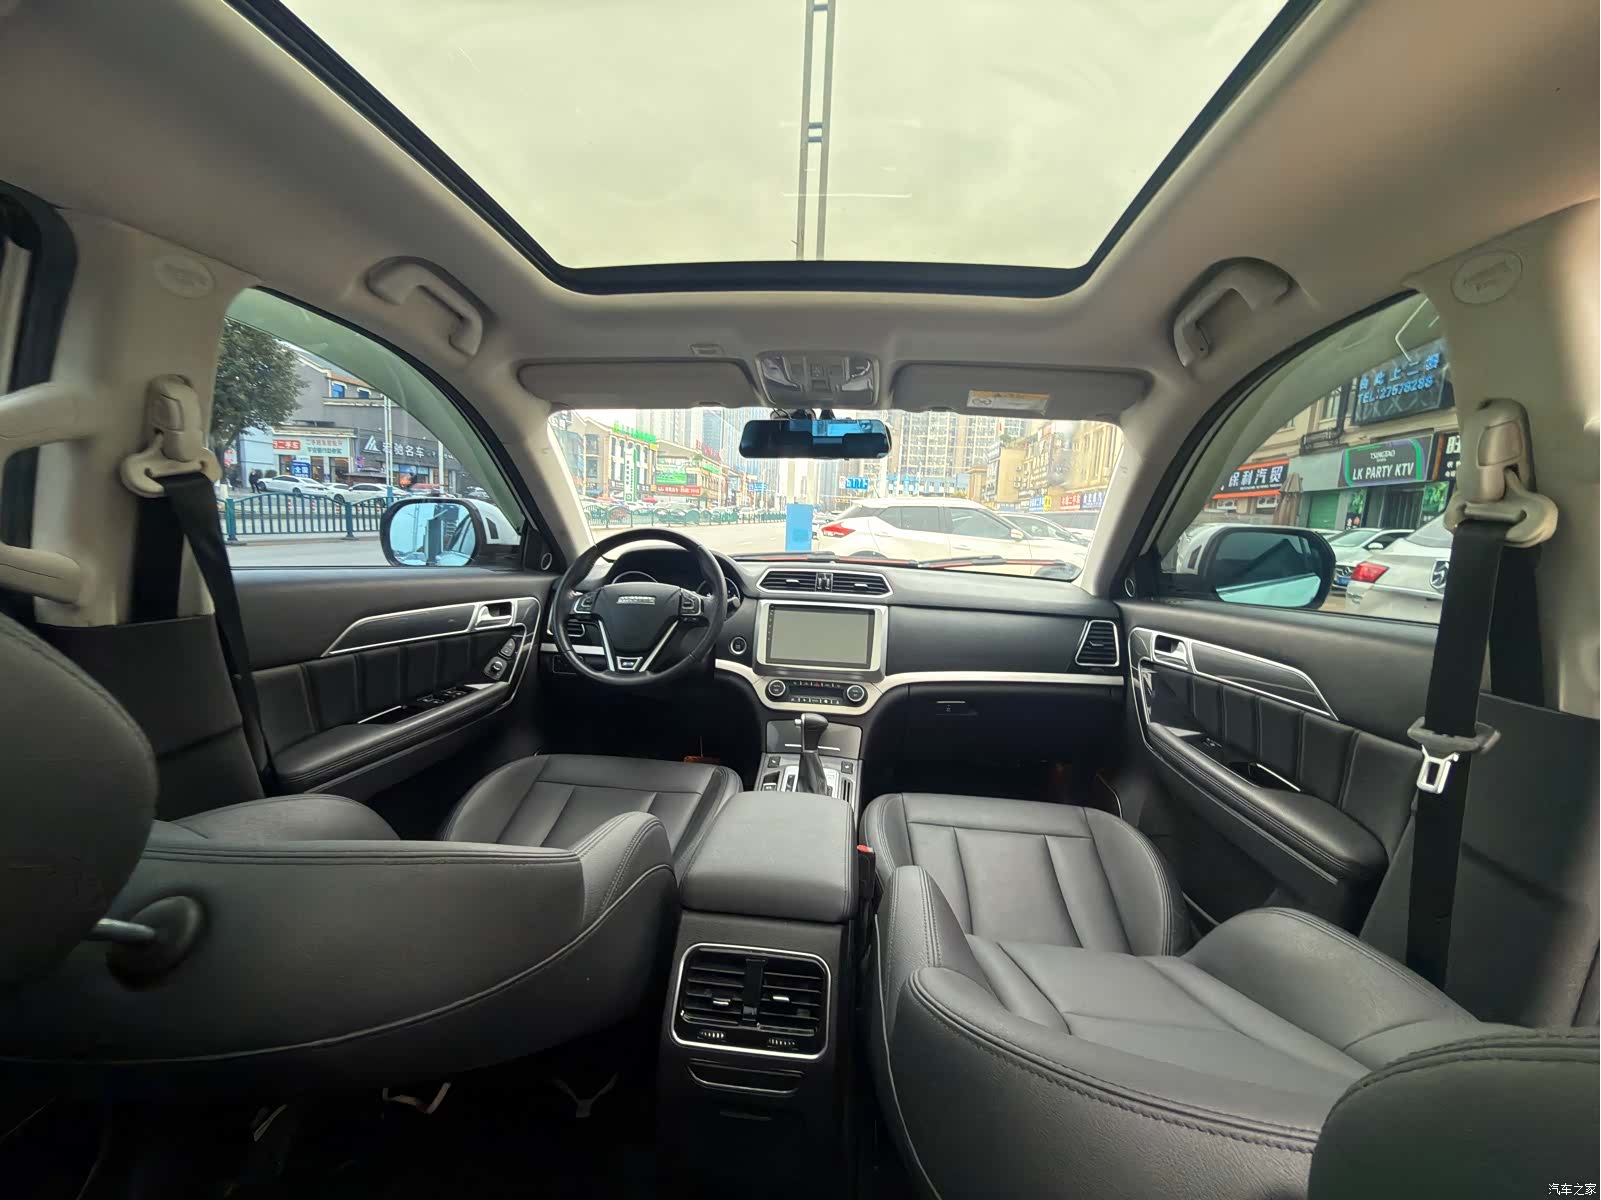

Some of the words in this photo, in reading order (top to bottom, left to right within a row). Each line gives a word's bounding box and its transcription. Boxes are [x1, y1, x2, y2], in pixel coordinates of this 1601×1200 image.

[1228, 465, 1284, 488] 保利汽贸
[1352, 467, 1364, 481] LK
[1365, 464, 1393, 480] PARTY
[1395, 462, 1414, 477] KTV
